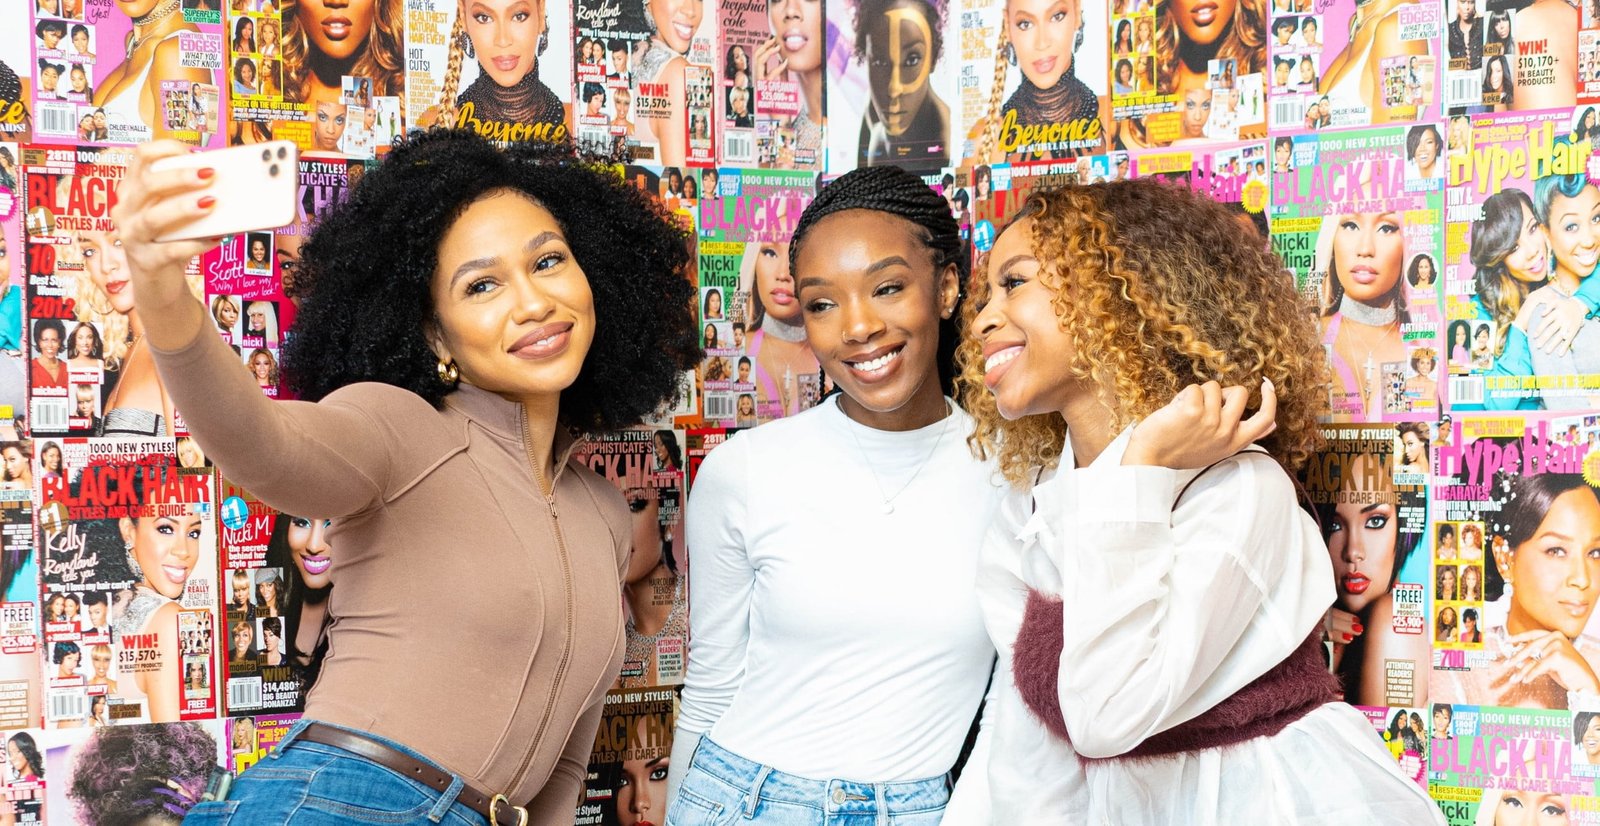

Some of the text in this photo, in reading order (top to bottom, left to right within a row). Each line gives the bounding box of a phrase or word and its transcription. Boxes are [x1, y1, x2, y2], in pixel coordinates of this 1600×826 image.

[723, 14, 746, 27] cole
[1400, 10, 1438, 25] EDGES!
[606, 18, 618, 31] you
[1403, 23, 1435, 32] WHAT YOU
[1400, 31, 1438, 40] MUST KNOW
[181, 40, 222, 53] EDGES!
[1484, 45, 1500, 56] kelly
[1518, 39, 1548, 56] WIN!
[185, 52, 204, 60] WHAT
[409, 49, 423, 59] HOT
[182, 59, 221, 69] MUST KNOW
[409, 60, 430, 72] CUTS!
[1449, 59, 1466, 68] mary
[1518, 56, 1559, 69] $10,170+
[962, 65, 973, 75] HOT
[962, 75, 979, 88] CUTS!
[1518, 77, 1556, 86] PRODUCTS!
[639, 83, 669, 96] WIN!
[637, 97, 671, 108] $15,570+
[1483, 93, 1500, 103] keke
[1320, 134, 1404, 150] 1000 NEW STYLES!
[47, 150, 75, 161] 28TH
[77, 151, 100, 163] 1000
[1526, 120, 1592, 182] Hair
[311, 162, 347, 174] STYLES!
[1031, 164, 1049, 176] NEW
[1050, 162, 1076, 174] STYLES!
[742, 175, 813, 186] 1000 NEW STYLES!
[1273, 162, 1364, 206] BLACK
[1358, 201, 1383, 213] CARE
[701, 196, 781, 231] BLACK
[57, 217, 93, 231] STYLES
[1280, 218, 1321, 227] BEST-SELLING
[1272, 232, 1309, 252] Nicki
[216, 239, 238, 267] Jill
[29, 244, 55, 275] 10
[700, 255, 734, 272] Nicki
[209, 261, 244, 284] Scott
[704, 271, 741, 290] Minaj
[242, 291, 259, 299] new
[30, 297, 76, 319] 2012
[1411, 313, 1427, 324] WIG
[1400, 322, 1439, 333] ARTISTRY
[243, 334, 263, 347] nicki
[1403, 331, 1436, 340] BEST TIPS!
[623, 431, 652, 441] STYLES!
[1339, 429, 1393, 440] NEW STYLES!
[89, 442, 175, 453] 1000 NEW STYLES!
[581, 442, 653, 454] SOPHISTICATE'S
[1440, 420, 1589, 491] Hype Hair
[41, 467, 210, 506] BLACK HAIR
[1350, 492, 1401, 504] CARE GUIDE
[69, 504, 186, 519] STYLES AND CARE GUIDE
[222, 498, 242, 525] #1
[45, 525, 86, 558] Kelly
[223, 523, 253, 548] Nicki
[242, 544, 268, 552] secrets
[228, 552, 252, 560] behind
[43, 553, 99, 576] Rowland
[229, 560, 267, 568] style game
[80, 570, 95, 583] you
[1396, 590, 1422, 603] FREE!
[4, 607, 33, 622] FREE!
[256, 608, 271, 616] tyra
[122, 633, 158, 649] WIN!
[119, 651, 162, 662] $15,570+
[1441, 650, 1465, 668] 700
[230, 662, 255, 671] monica
[262, 667, 291, 681] WIN!
[263, 681, 300, 692] $14,480+
[263, 691, 298, 700] BIG BEAUTY
[625, 690, 672, 703] NEW STYLES!
[187, 699, 208, 708] FREE!
[263, 700, 296, 708] BONANZA!
[1456, 720, 1477, 728] SHORT
[1481, 713, 1571, 728] 1000 NEW STYLES!
[618, 748, 655, 761] AND CARE
[1431, 736, 1530, 778] BLACK
[1439, 786, 1482, 796] BEST-SELLING
[1521, 780, 1548, 792] CARE
[587, 789, 612, 798] Rihanna
[581, 805, 601, 816] Styled
[596, 814, 603, 823] of
